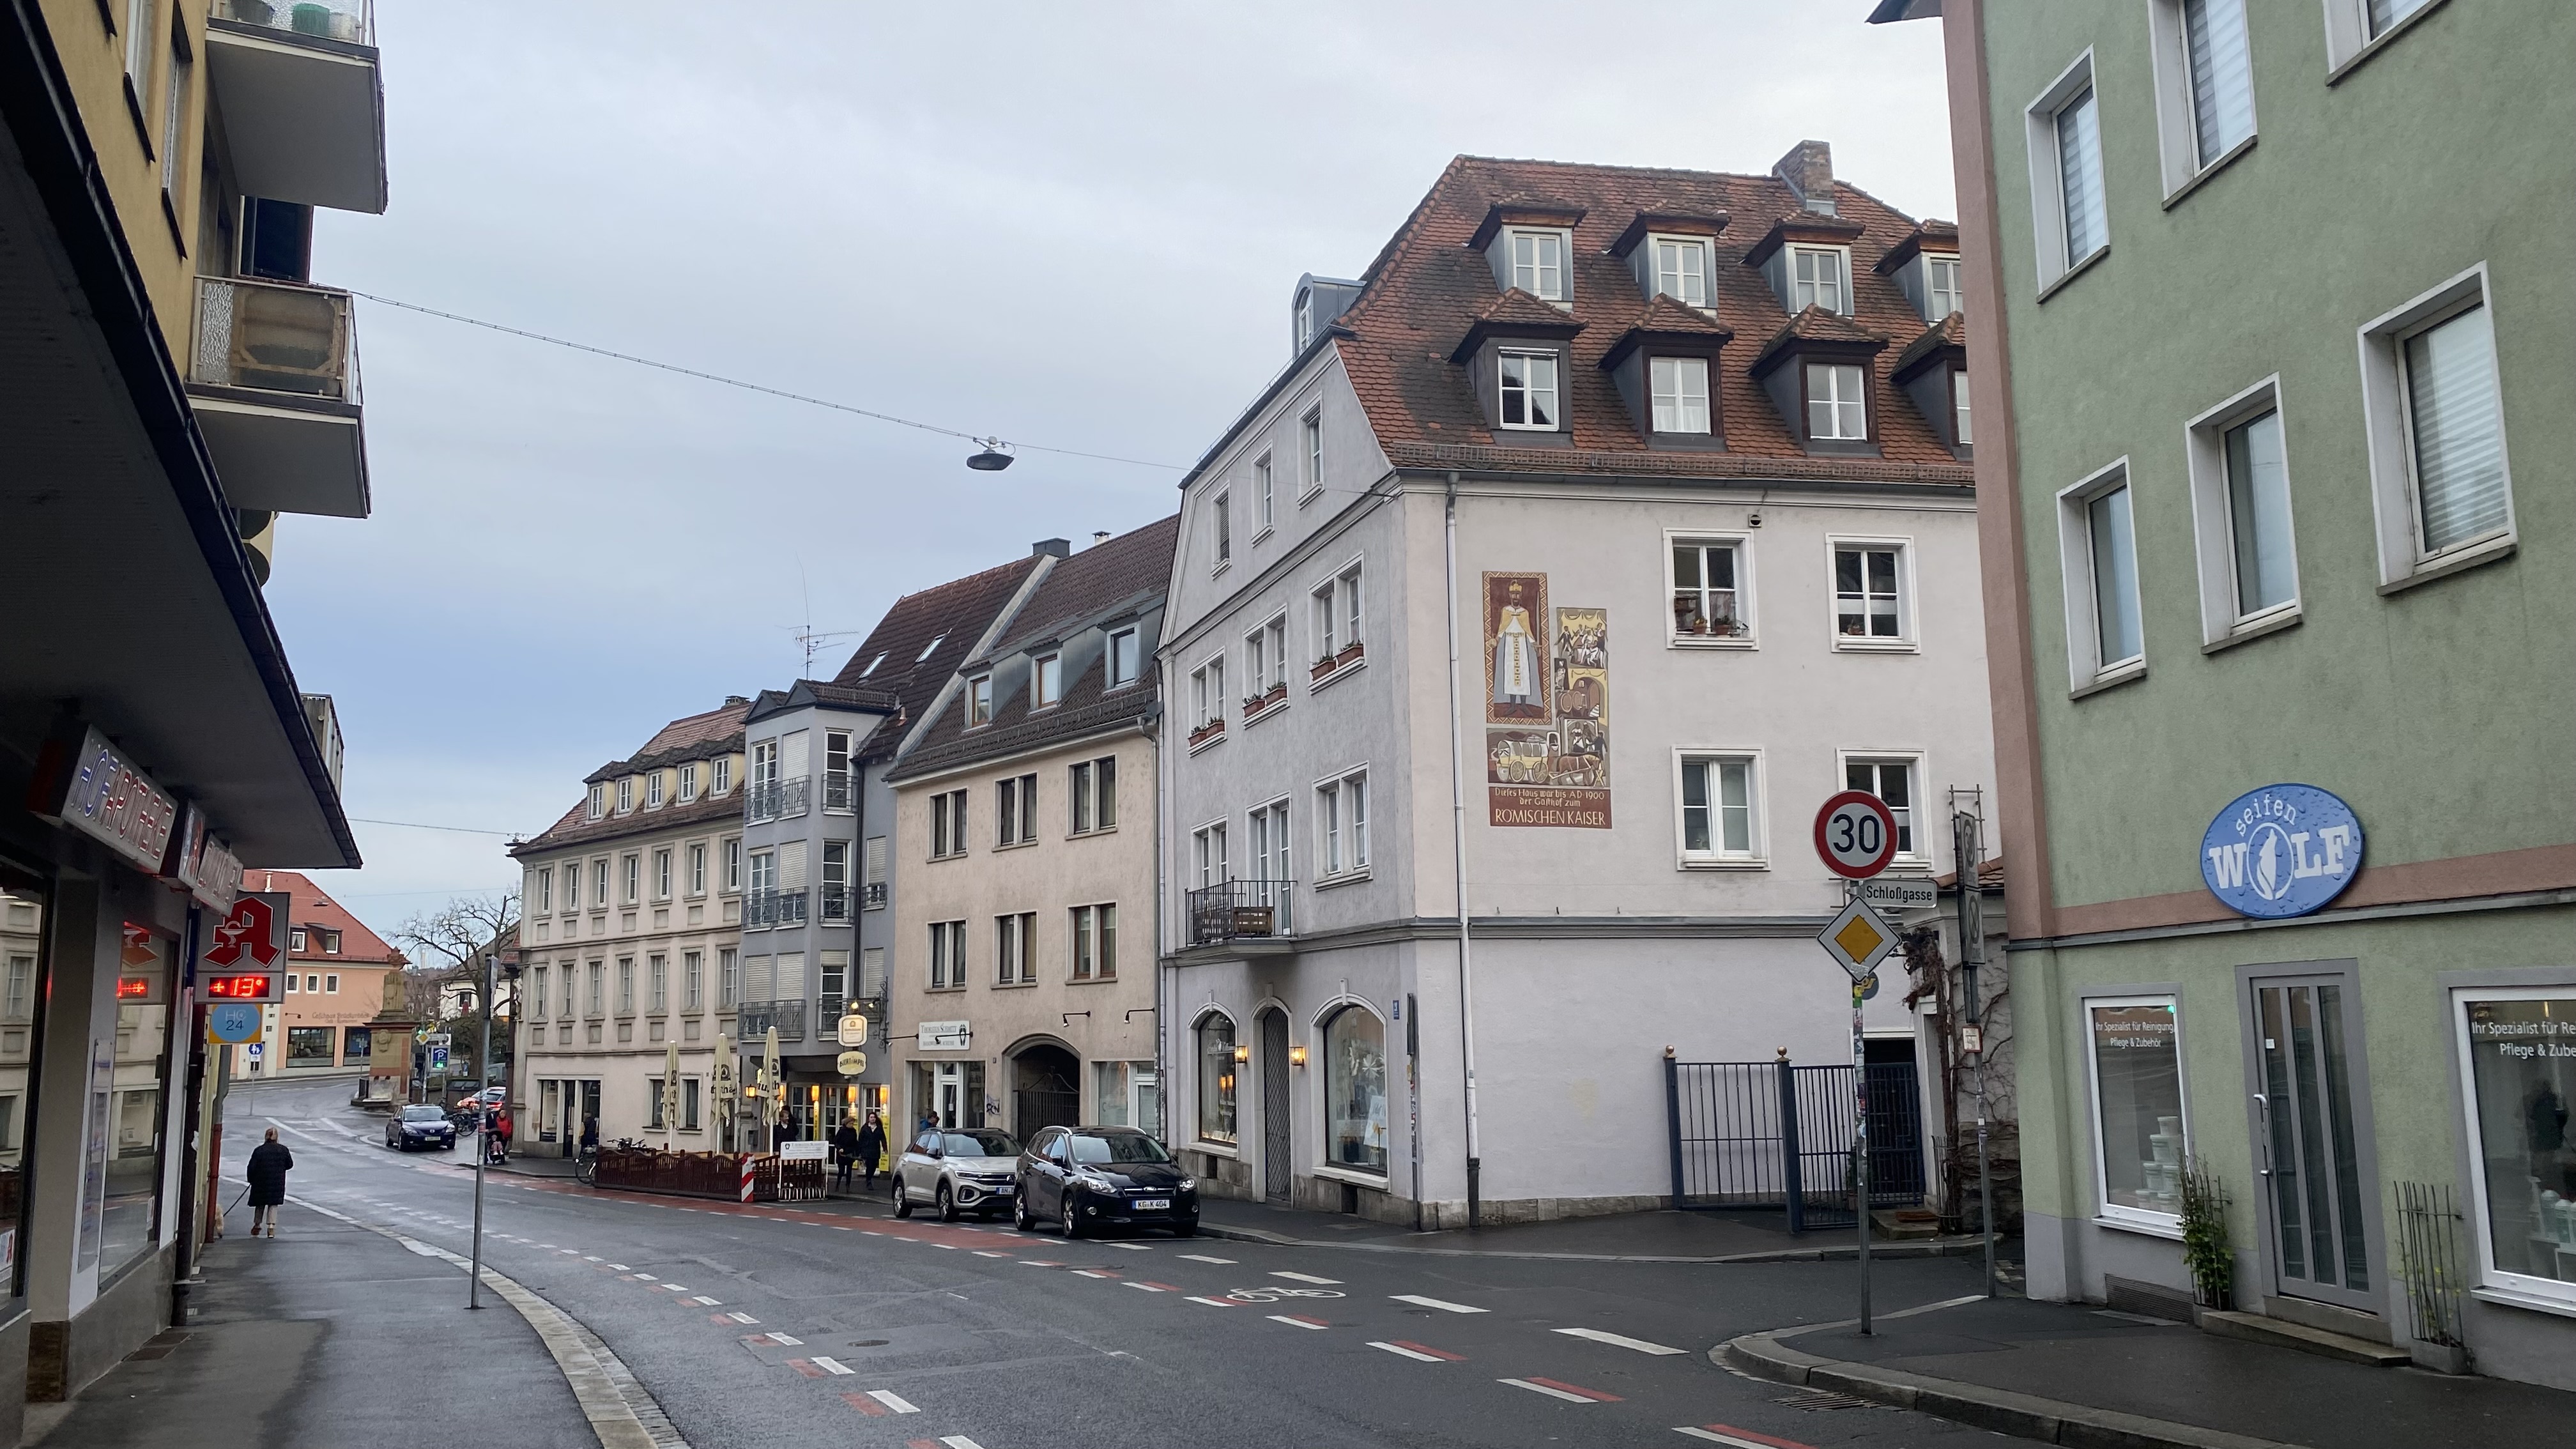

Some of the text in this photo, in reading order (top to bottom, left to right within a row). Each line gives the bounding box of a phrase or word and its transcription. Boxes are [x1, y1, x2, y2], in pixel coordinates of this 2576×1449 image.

[1518, 788, 1538, 797] Haus
[1555, 789, 1567, 798] bis
[1586, 791, 1604, 800] 1900
[1519, 797, 1531, 805] der
[1495, 808, 1606, 825] RÖMISCHEN KAISER
[2236, 794, 2296, 837] seifen
[1833, 814, 1880, 854] 30
[1866, 885, 1933, 903] Schloßgasse
[226, 1020, 243, 1031] 24
[2104, 1022, 2131, 1032] Spezialist
[2132, 1022, 2141, 1031] für
[2472, 1022, 2486, 1034] Ihr
[2489, 1020, 2539, 1037] Spezialist
[2541, 1020, 2558, 1034] für
[2110, 1037, 2161, 1048] Pflege & Zubehör
[2500, 1043, 2534, 1059] Pflege
[2538, 1043, 2546, 1056] &
